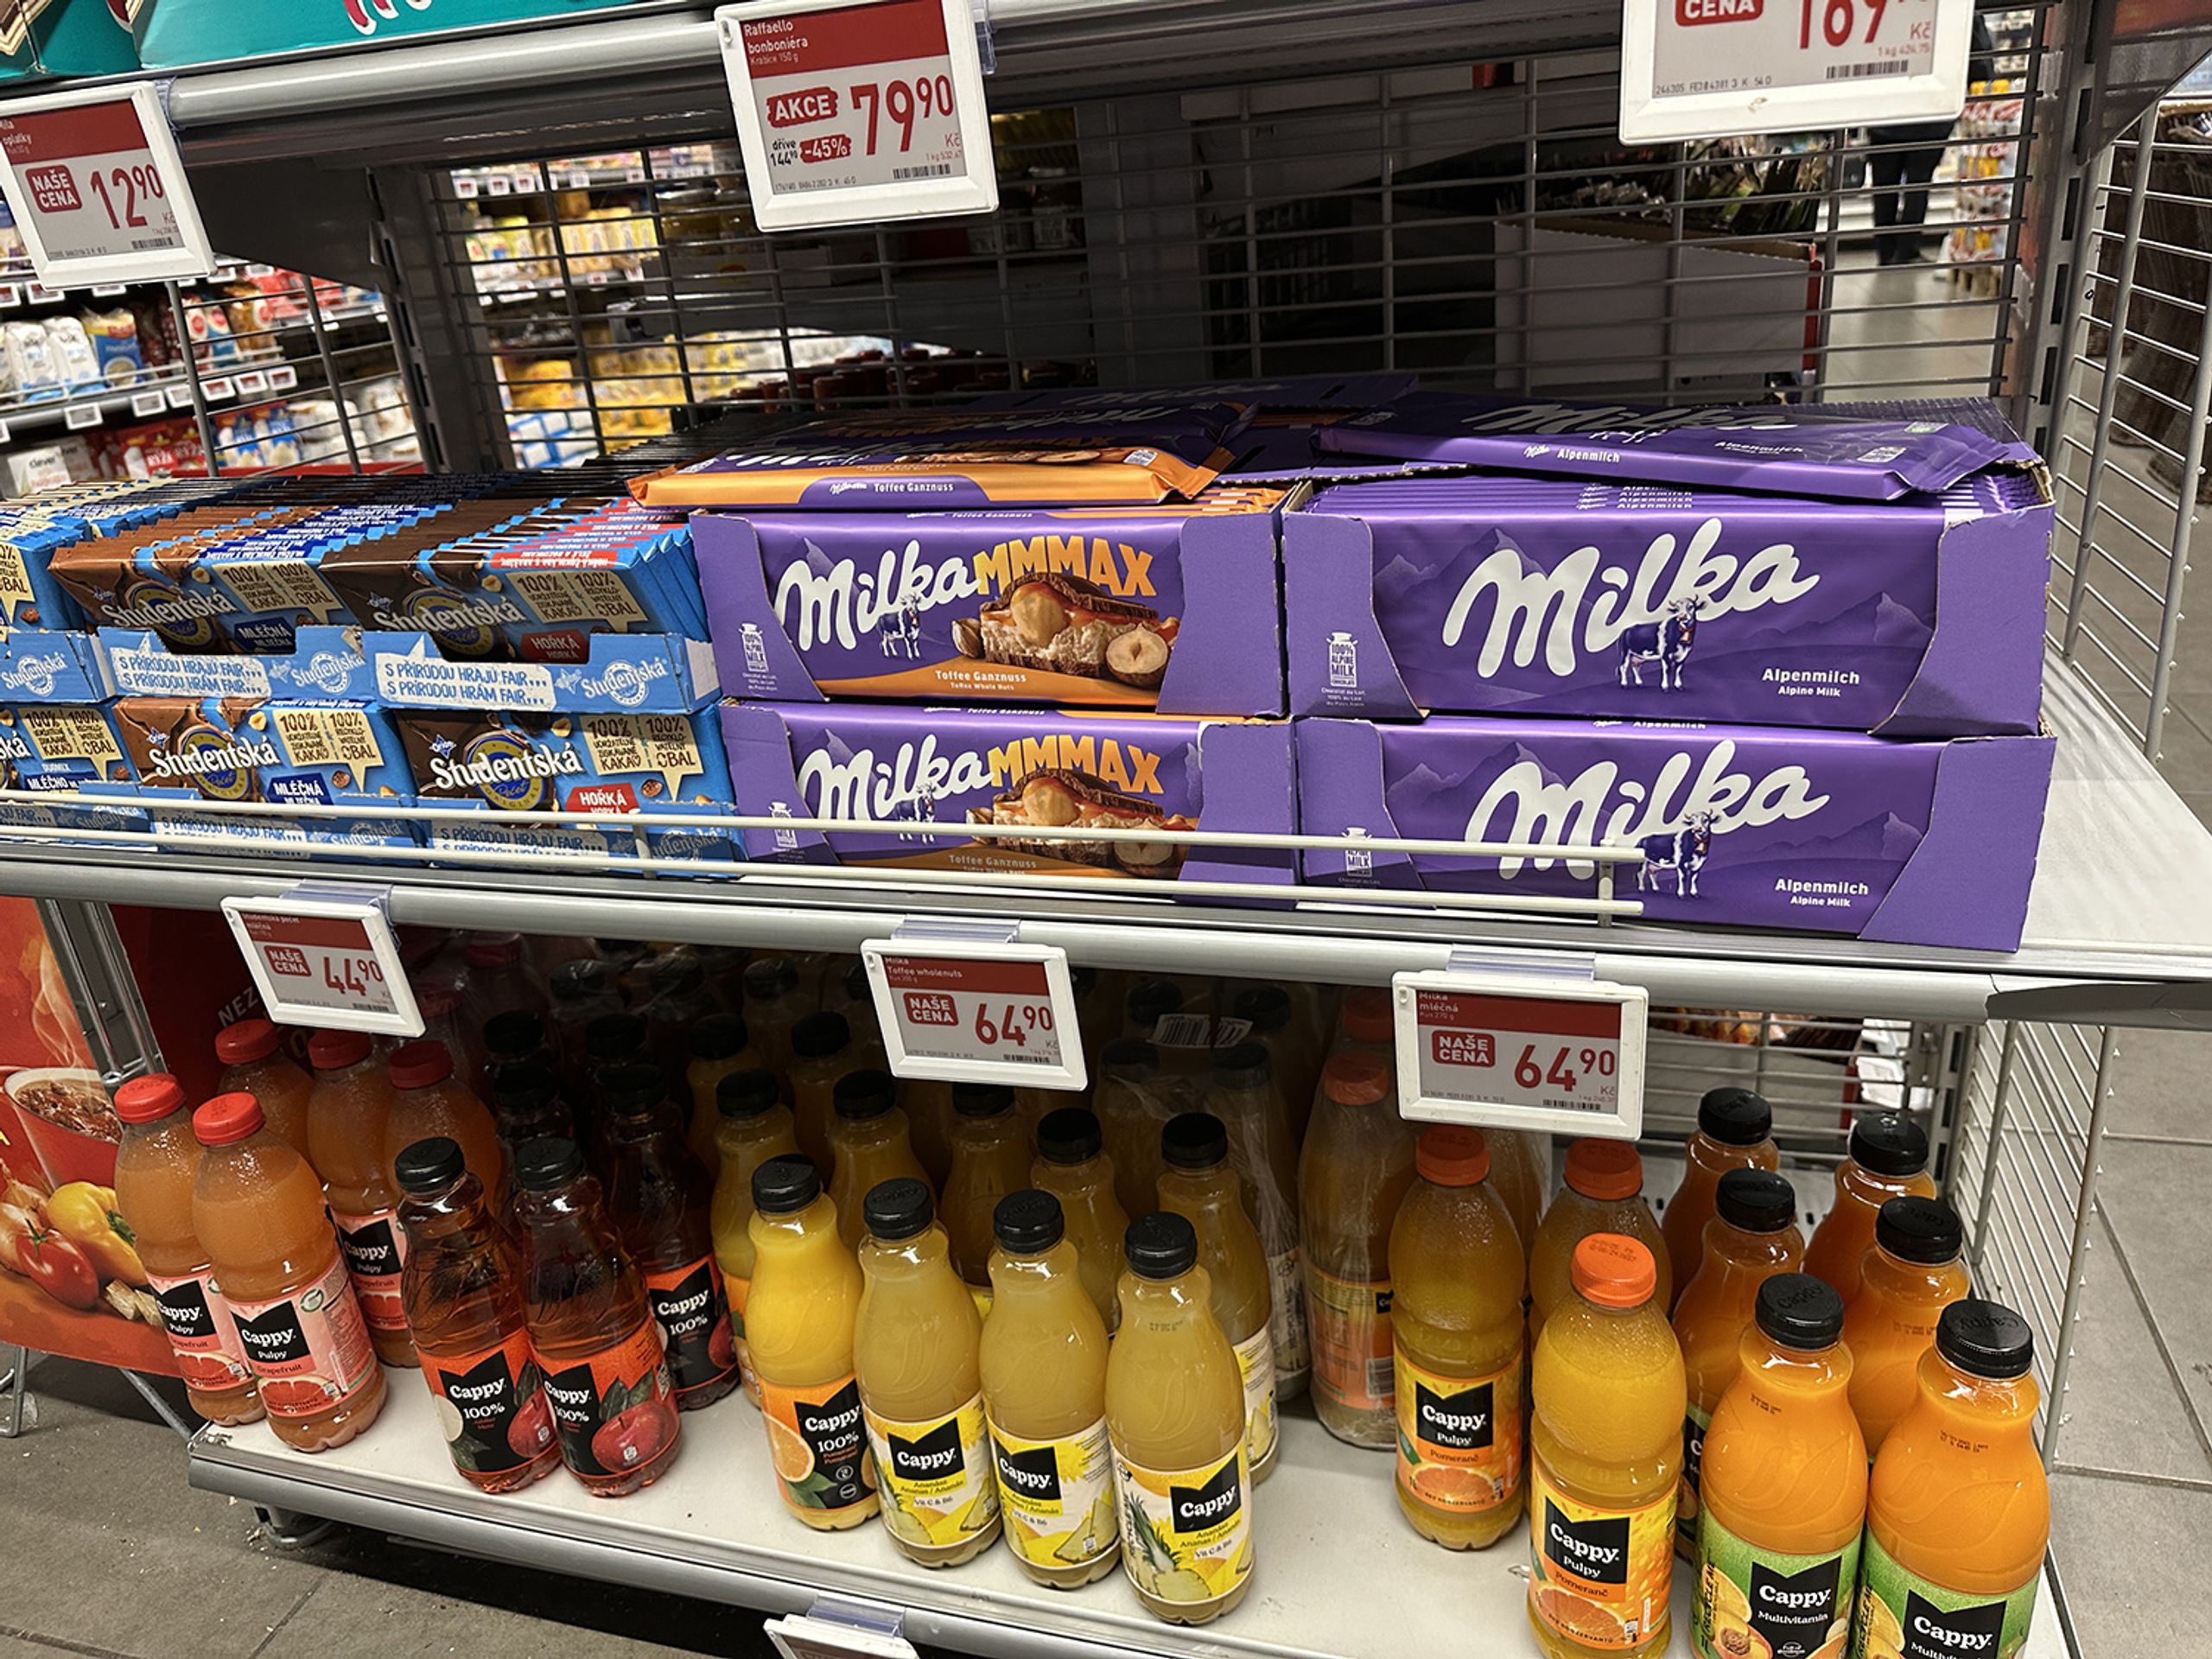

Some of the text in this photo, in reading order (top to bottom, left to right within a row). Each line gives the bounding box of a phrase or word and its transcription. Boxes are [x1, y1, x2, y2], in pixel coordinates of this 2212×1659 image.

[744, 20, 794, 37] Raffaello
[1910, 22, 1931, 40] Kč
[747, 36, 809, 54] bonboniéra
[775, 94, 831, 121] AKCE
[772, 138, 797, 150] dříve
[804, 137, 849, 159] -45%
[944, 132, 961, 148] Kč
[32, 168, 69, 191] NAŠE
[39, 190, 78, 208] CENA
[1557, 448, 1621, 464] Alpenmilch
[874, 482, 906, 493] Toffee
[907, 482, 955, 493] Ganznuss
[223, 566, 264, 585] 100%
[272, 563, 309, 578] 100%
[575, 571, 616, 588] 100%
[518, 574, 563, 594] 100%
[296, 590, 334, 606] OBAL
[775, 535, 1157, 652] Milka MMMAX
[1442, 518, 1821, 678] Milka
[101, 588, 241, 628] Studentská
[373, 594, 528, 633] Studentská
[596, 601, 638, 617] OBAL
[238, 623, 292, 639] MLÉČNÁ
[531, 633, 580, 650] HOŘKÁ
[1332, 644, 1354, 655] 100%
[2, 652, 67, 690] Studentská
[119, 656, 129, 671] S
[130, 653, 180, 677] PŘÍRODOU
[385, 664, 395, 677] S
[397, 660, 454, 681] PŘÍRODOU
[1332, 664, 1355, 677] MILK
[123, 671, 131, 685] S
[133, 670, 181, 690] PŘÍRODOU
[185, 673, 222, 692] HRÁM
[581, 657, 668, 700] Studentská
[935, 669, 1027, 683] Toffee Ganznuss
[1762, 668, 1860, 685] Alpenmilch
[387, 681, 396, 695] S
[399, 679, 457, 699] PŘÍRODOU
[461, 681, 497, 702] HRÁM
[1778, 685, 1841, 698] Alpine Milk
[25, 710, 60, 729] 100%
[68, 709, 99, 724] 100%
[280, 713, 319, 734] 100%
[329, 711, 363, 728] 100%
[646, 716, 684, 733] 100%
[588, 718, 632, 740] 100%
[83, 740, 115, 756] OBAL
[149, 736, 280, 778] Studentská
[340, 744, 376, 761] OBAL
[430, 742, 585, 790] Studentská
[657, 751, 696, 768] OBAL
[798, 734, 1164, 820] Milka MMMAX
[272, 776, 324, 797] MLÉČNÁ
[580, 789, 627, 807] HOŘKÁ
[1465, 739, 1830, 880] Milka
[441, 827, 449, 841] S
[950, 854, 1037, 869] Toffee Ganznuss
[1775, 876, 1869, 896] Alpenmilch
[1790, 894, 1851, 908] Alpine Milk
[270, 948, 302, 963] NAŠE
[274, 962, 308, 975] CENA
[888, 966, 963, 978] Toffee wholenuts
[910, 995, 950, 1010] NAŠE
[1420, 1002, 1459, 1013] mléčná
[912, 1011, 954, 1023] CENA
[1440, 1034, 1488, 1052] NAŠE
[1439, 1050, 1490, 1064] CENA
[1600, 1085, 1616, 1096] Kč
[345, 1242, 391, 1261] Cappy
[356, 1262, 382, 1274] Pulpy
[156, 1300, 200, 1321] Cappy
[658, 1289, 709, 1317] Cappy
[169, 1323, 194, 1335] Pulpy
[669, 1314, 708, 1336] 100%
[241, 1328, 294, 1348] Cappy
[257, 1350, 287, 1361] Pulpy
[257, 1363, 302, 1376] Grapefruit
[449, 1376, 505, 1402] Cappy
[544, 1380, 590, 1404] Cappy
[464, 1402, 505, 1420] 100%
[554, 1407, 590, 1423] 100%
[804, 1404, 861, 1433] Cappy
[1422, 1403, 1485, 1431] Cappy
[817, 1430, 860, 1452] 100%
[1437, 1433, 1471, 1446] Pulpy
[897, 1447, 956, 1470] Cappy
[1430, 1449, 1478, 1463] Pomeranč
[1000, 1457, 1052, 1490] Cappy
[1179, 1484, 1236, 1518] Cappy
[1550, 1522, 1620, 1565] Cappy
[1563, 1555, 1601, 1579] Pulpy
[1555, 1571, 1609, 1598] Pomeranč
[1758, 1585, 1831, 1609] Cappy
[1758, 1610, 1828, 1625] Multivitamin
[1913, 1615, 1993, 1649] Cappy
